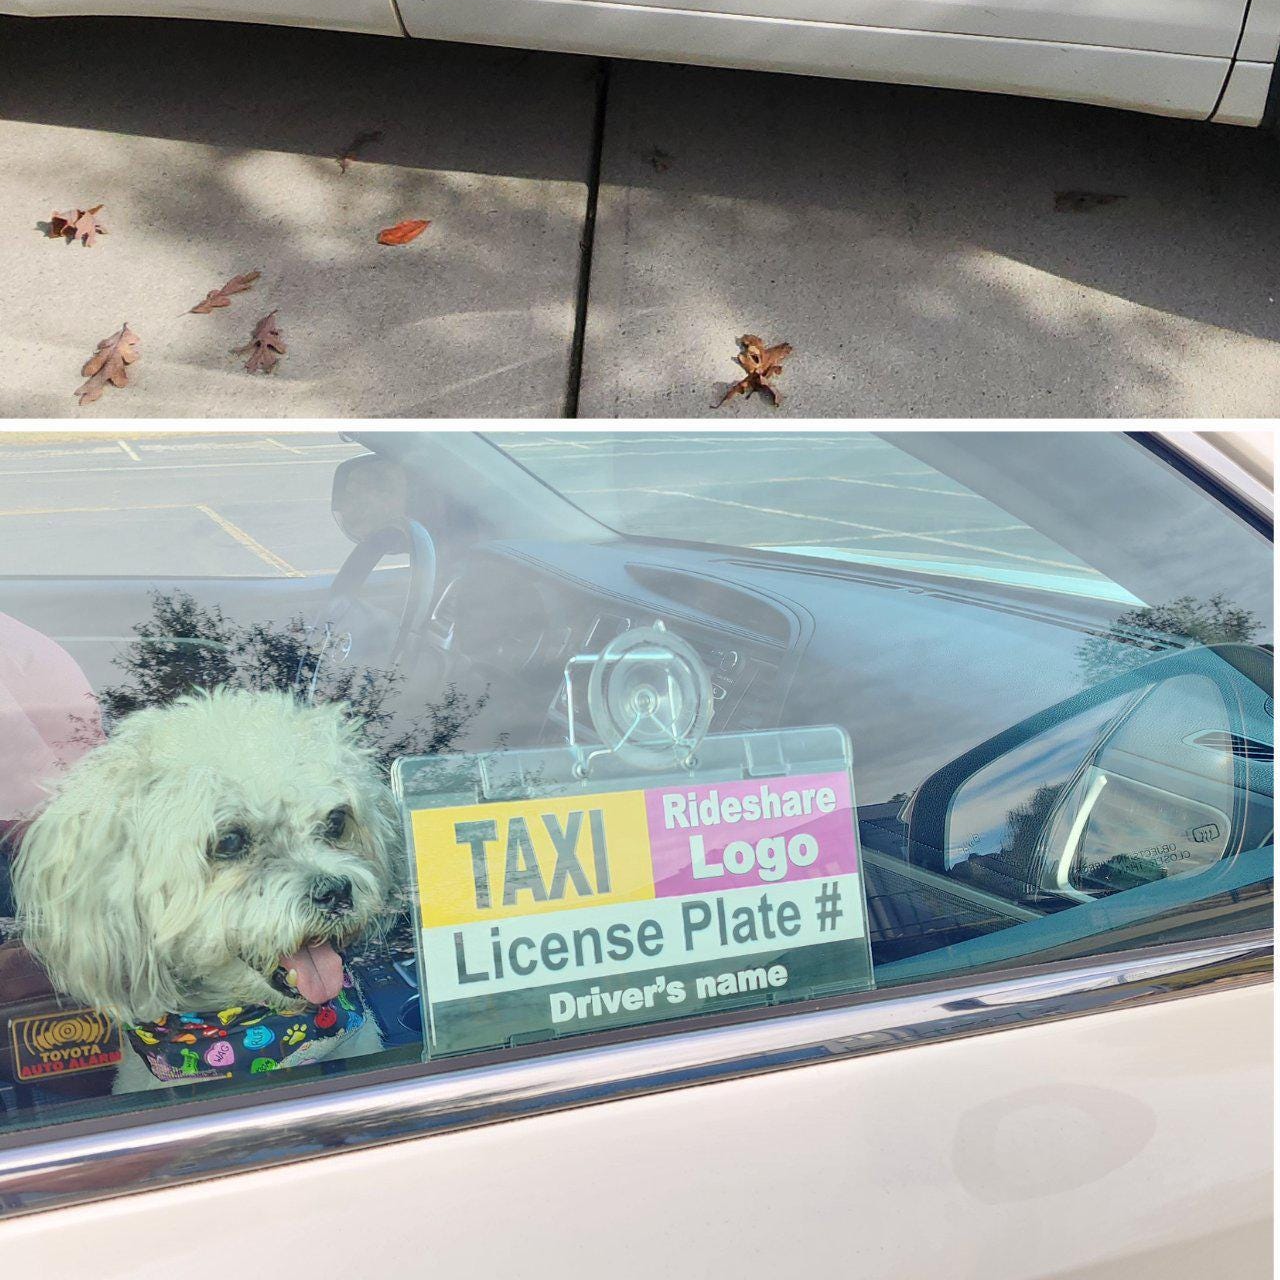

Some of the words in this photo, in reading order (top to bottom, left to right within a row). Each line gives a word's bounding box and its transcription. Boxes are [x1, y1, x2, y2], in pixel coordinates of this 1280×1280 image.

[662, 784, 836, 831] Rideshare
[454, 809, 613, 911] TAXI
[688, 832, 819, 882] Logo
[453, 920, 664, 985] License
[681, 893, 802, 952] Plate
[814, 881, 844, 933] #
[549, 975, 687, 1025] Driver's
[696, 962, 788, 1000] name
[20, 1061, 65, 1077] AUTO
[68, 1050, 122, 1069] ALARM
[40, 1044, 102, 1063] TOYOTA
[214, 1044, 230, 1063] WAG
